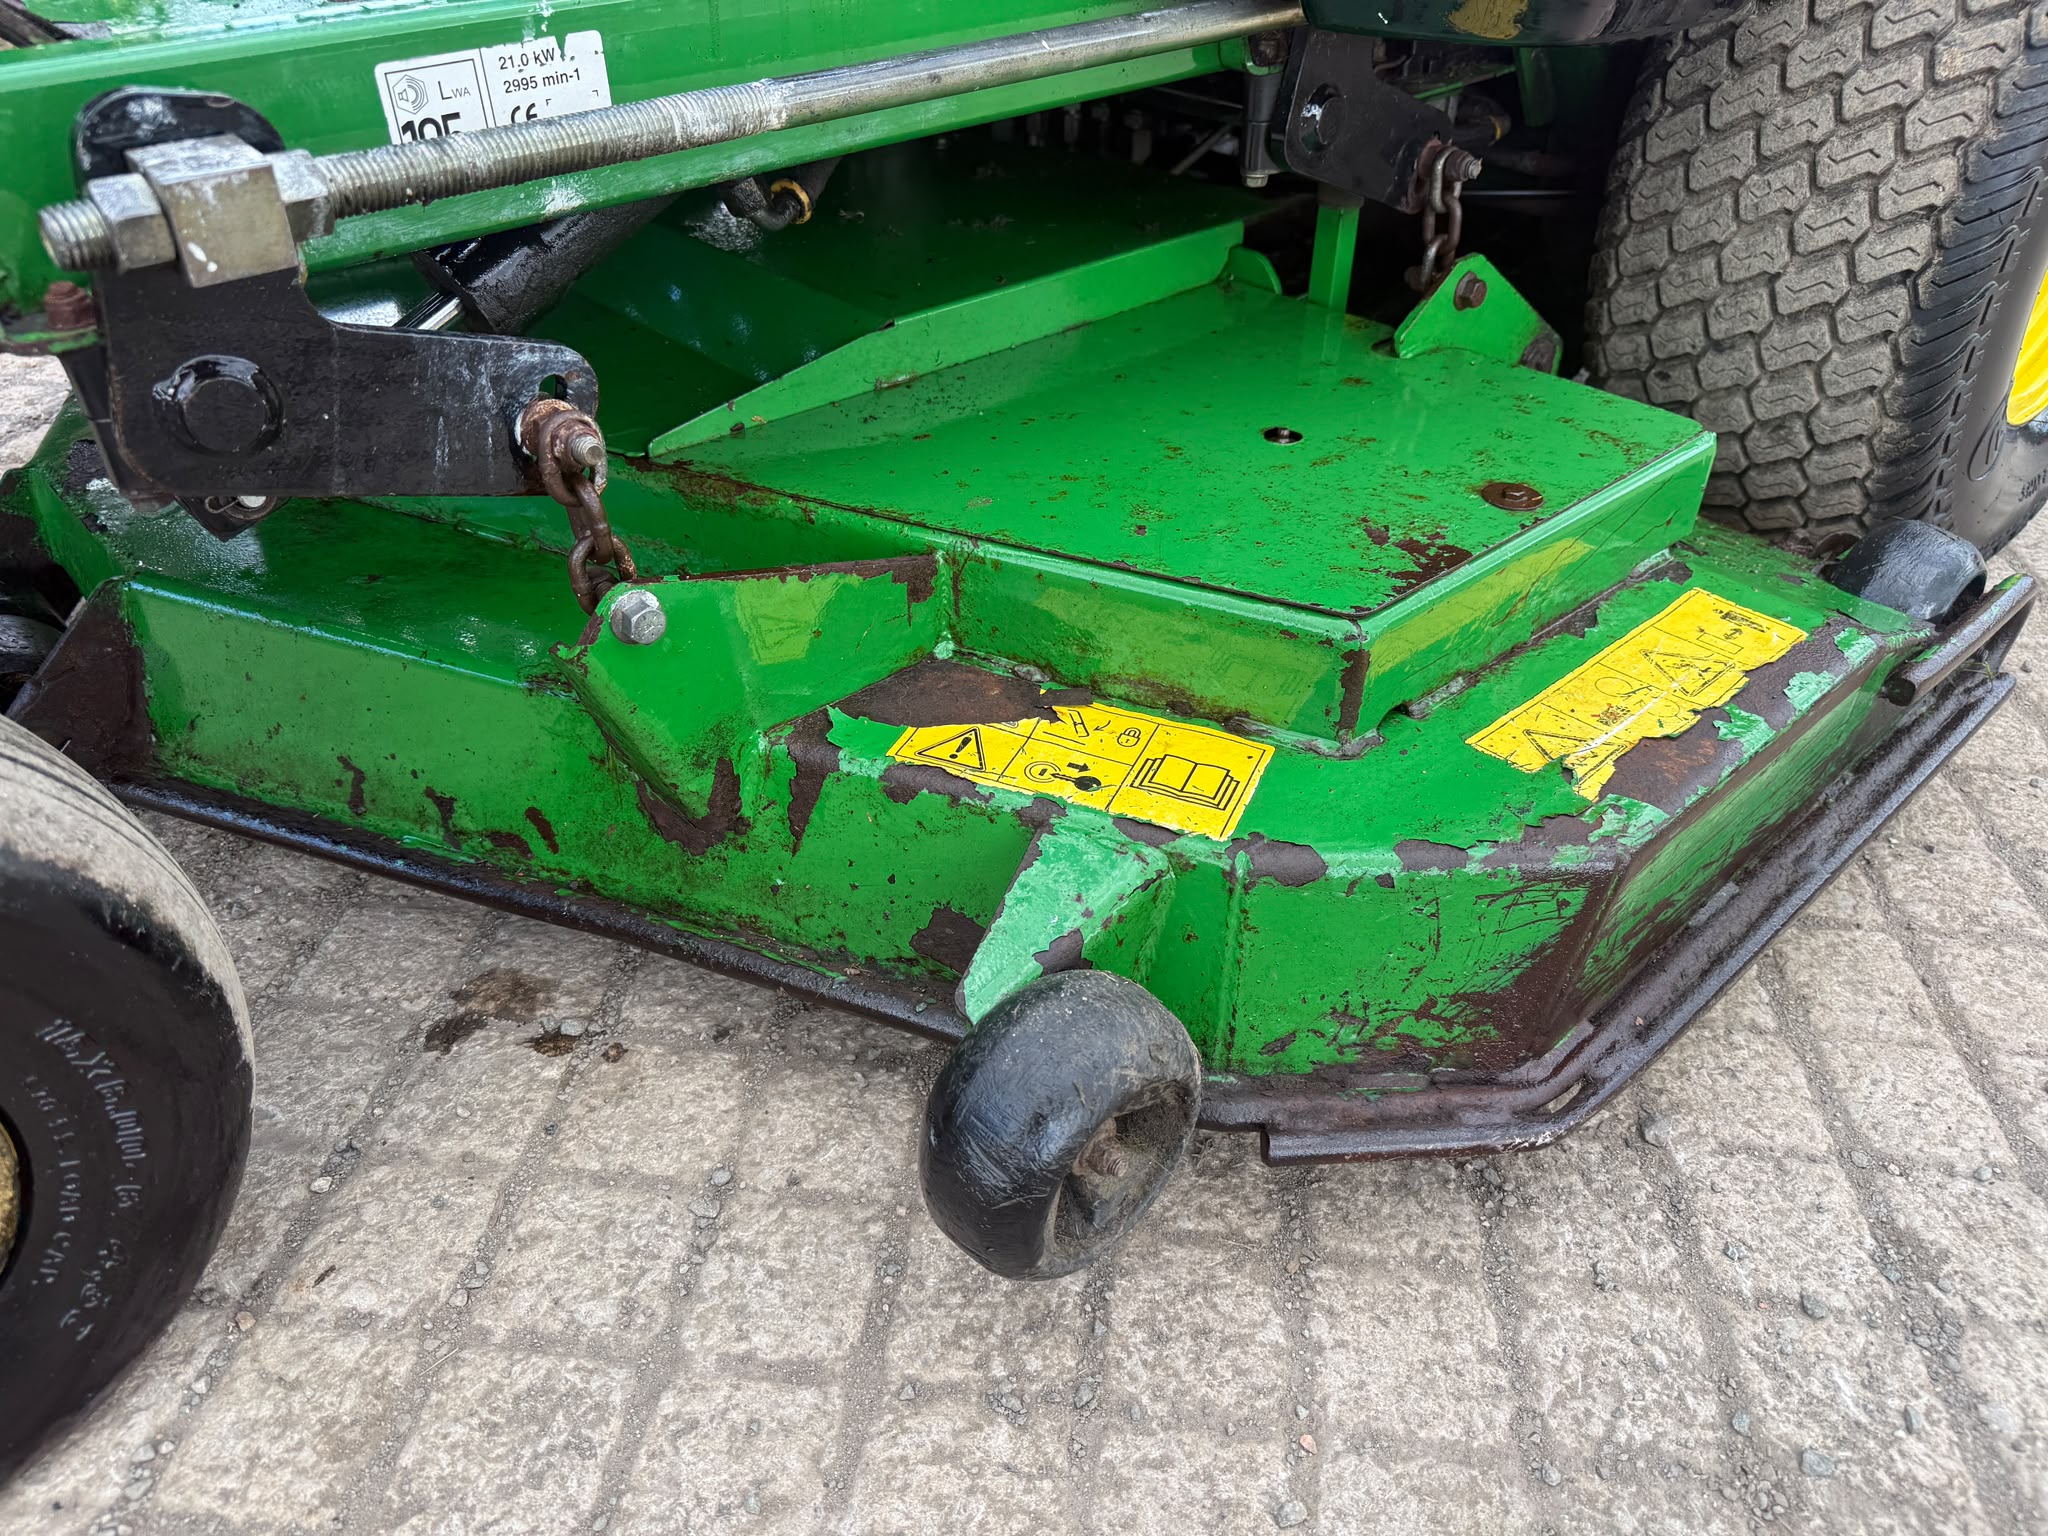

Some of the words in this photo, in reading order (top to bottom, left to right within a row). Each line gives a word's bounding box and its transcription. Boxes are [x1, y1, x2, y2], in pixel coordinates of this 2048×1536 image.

[499, 53, 529, 70] 21.0
[533, 48, 555, 64] kW
[503, 76, 538, 93] 2995
[542, 68, 580, 87] min-1
